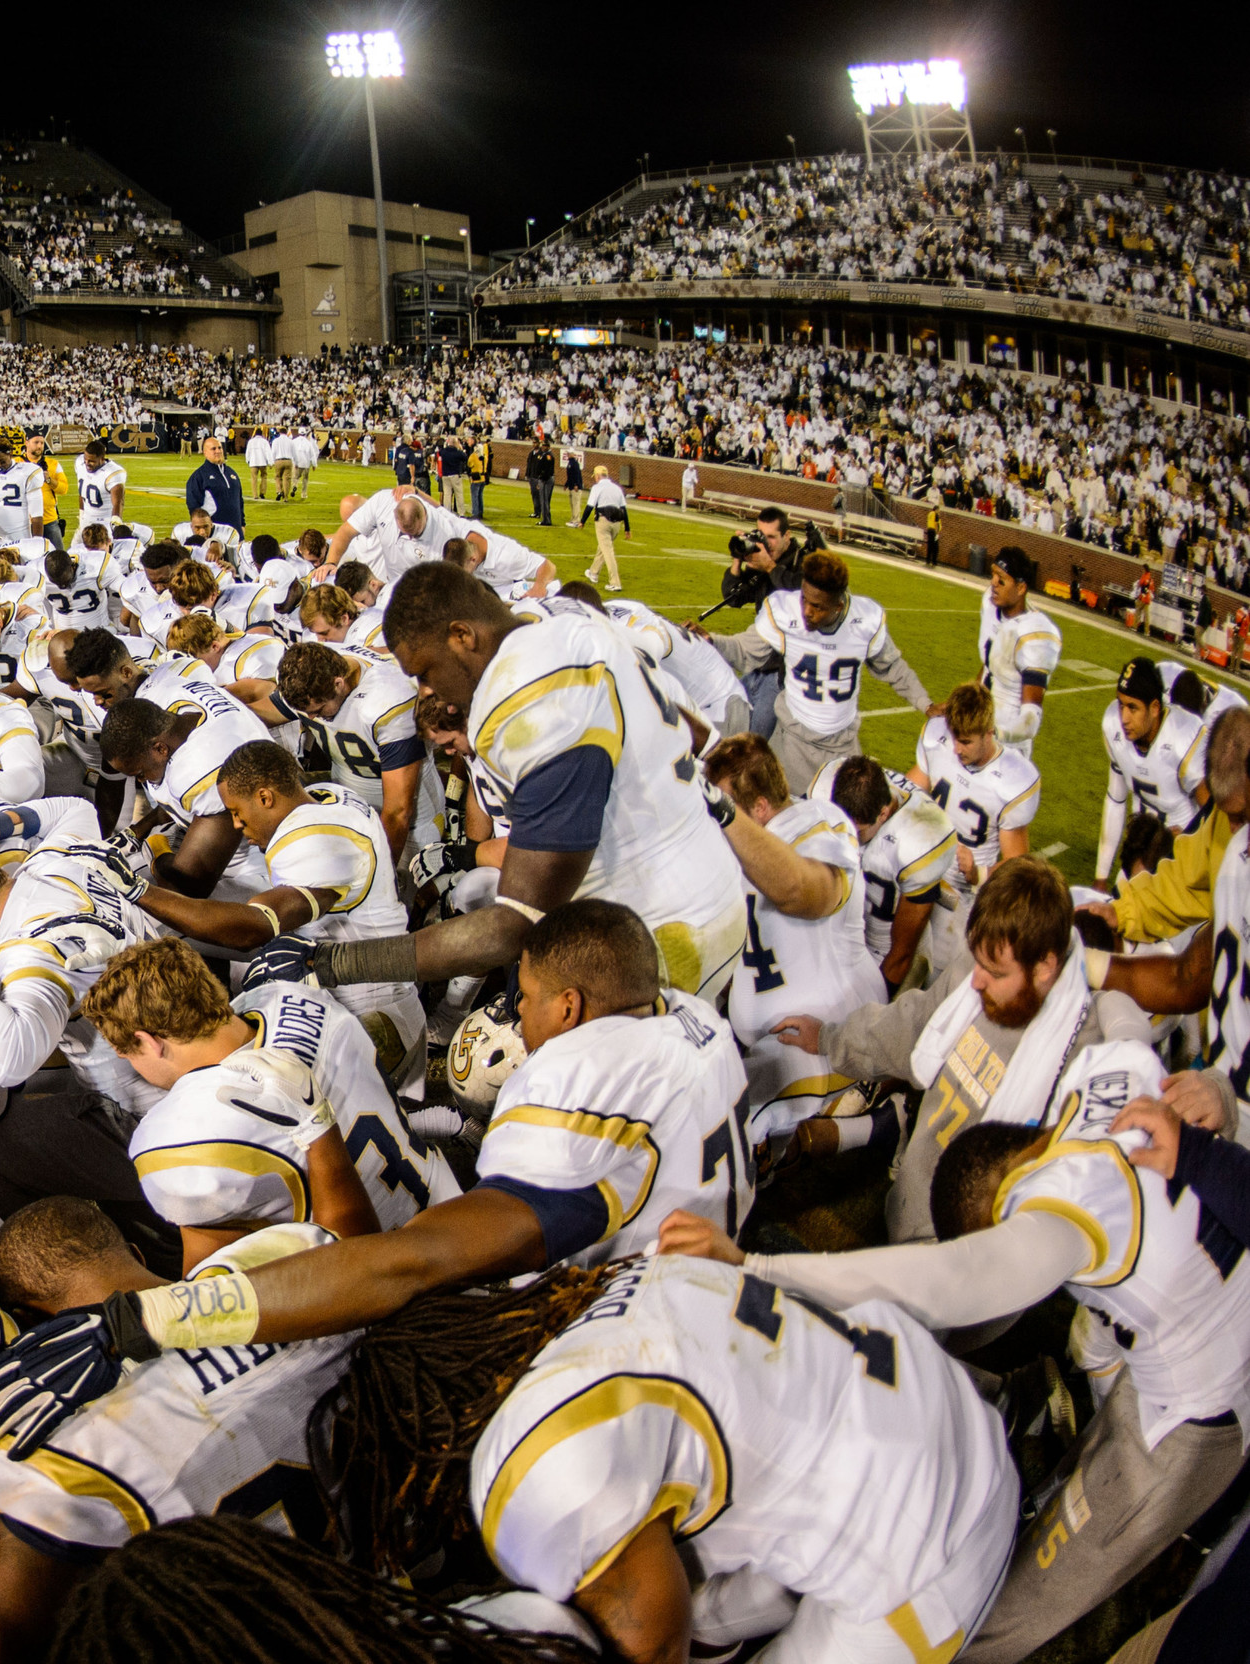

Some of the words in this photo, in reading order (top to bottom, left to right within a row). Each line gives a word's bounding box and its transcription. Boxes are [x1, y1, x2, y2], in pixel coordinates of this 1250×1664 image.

[771, 288, 798, 298] HALL
[800, 288, 816, 299] OF
[818, 288, 850, 299] FAME
[869, 292, 921, 305] BAUGHAN
[940, 289, 968, 298] GEORGE
[942, 296, 986, 310] MORRIS
[1015, 303, 1050, 318] DAVIS
[1192, 333, 1248, 356] FLOWERS
[78, 478, 103, 508] 10
[792, 654, 861, 702] 49
[1123, 664, 1136, 678] 5
[928, 1074, 971, 1149] 77
